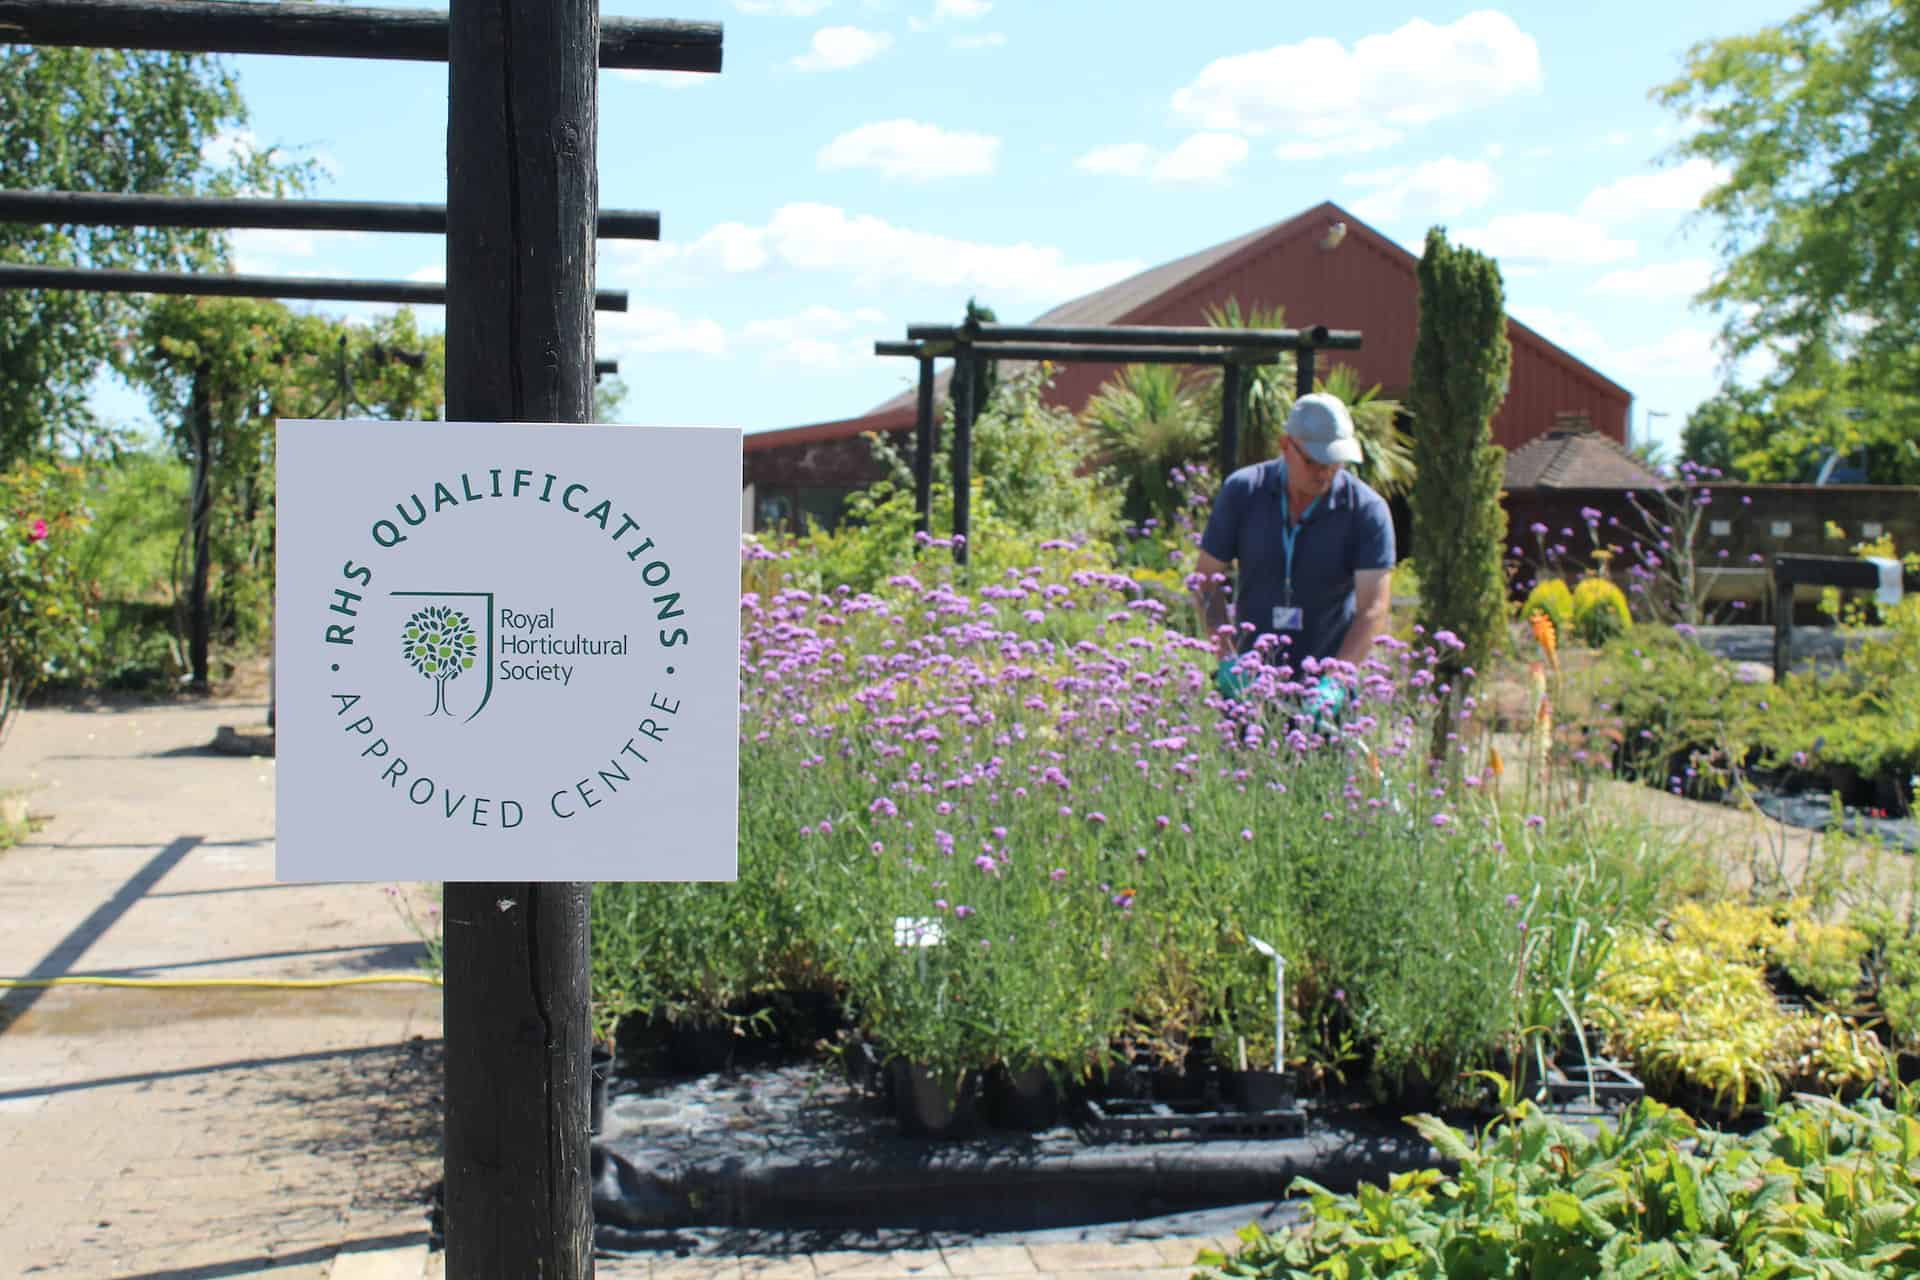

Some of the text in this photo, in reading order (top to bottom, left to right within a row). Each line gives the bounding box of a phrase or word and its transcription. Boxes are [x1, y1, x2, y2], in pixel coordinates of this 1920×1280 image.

[325, 469, 688, 647] RHS QUALIFICATIONS
[500, 607, 554, 635] Royal
[500, 634, 628, 656] Horticultural
[499, 660, 574, 687] Society
[331, 692, 681, 829] APPROVED CENTRE
